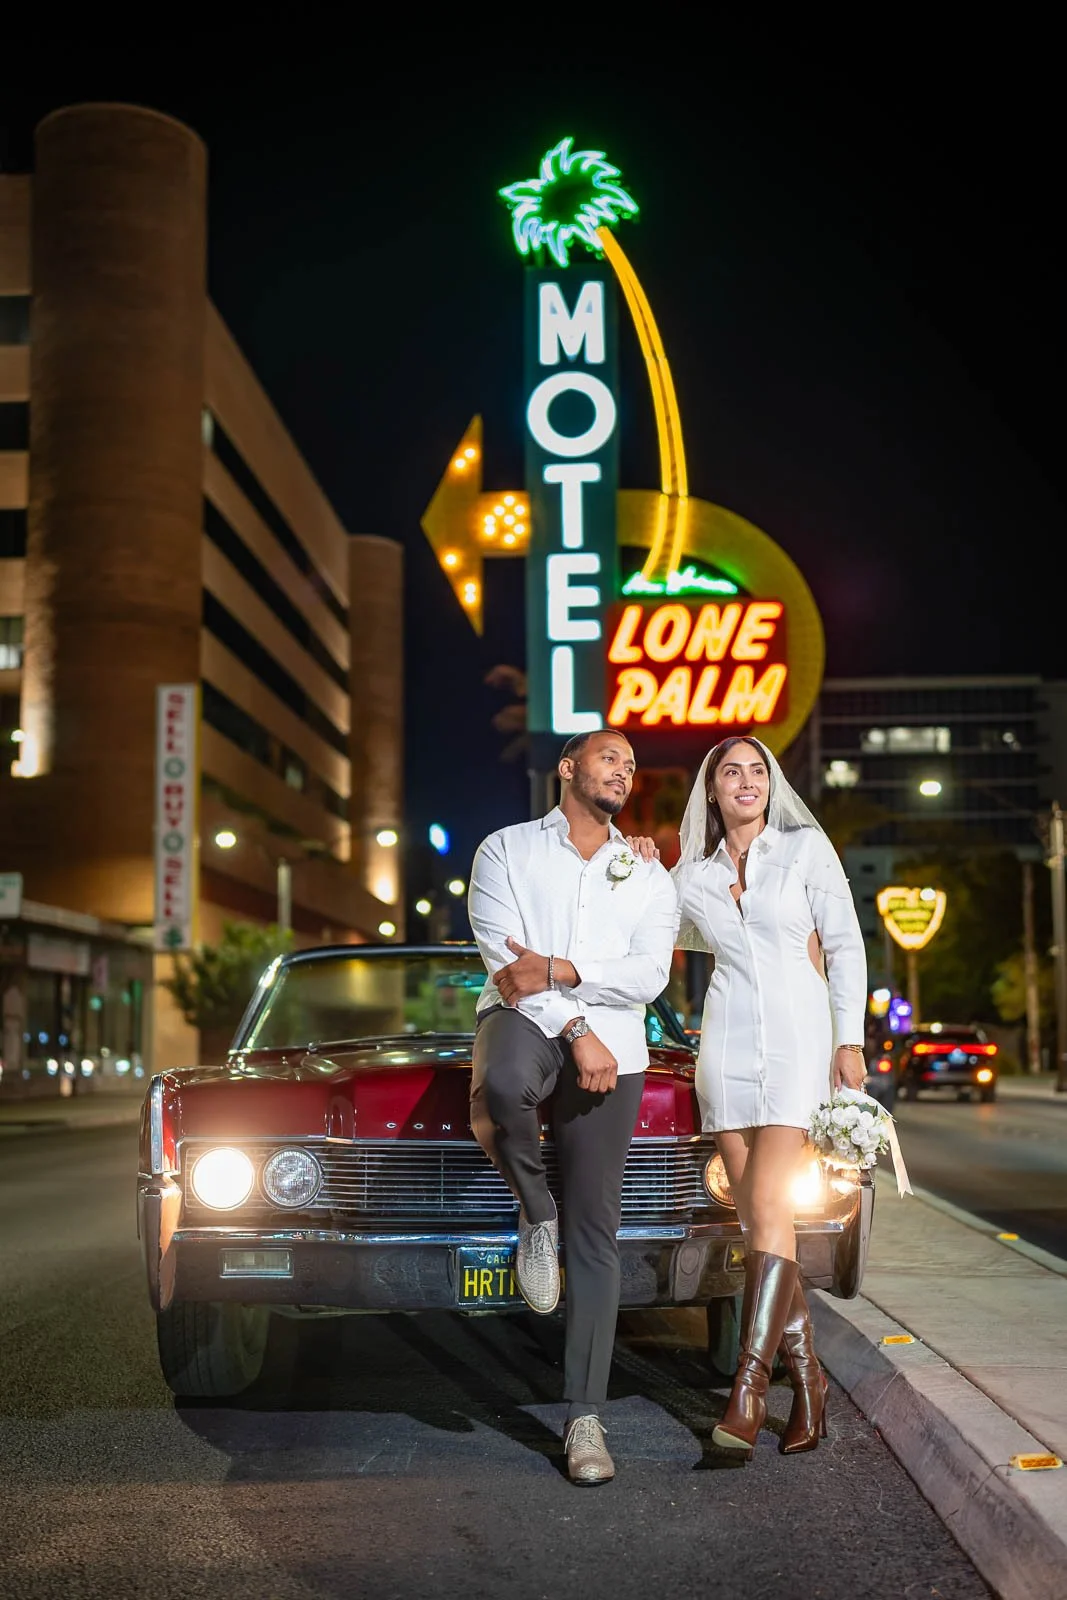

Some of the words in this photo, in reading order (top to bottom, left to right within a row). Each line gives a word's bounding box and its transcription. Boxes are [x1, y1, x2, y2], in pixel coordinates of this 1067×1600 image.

[526, 280, 617, 735] MOTEL
[607, 601, 784, 664] LONE
[606, 663, 788, 727] PALM
